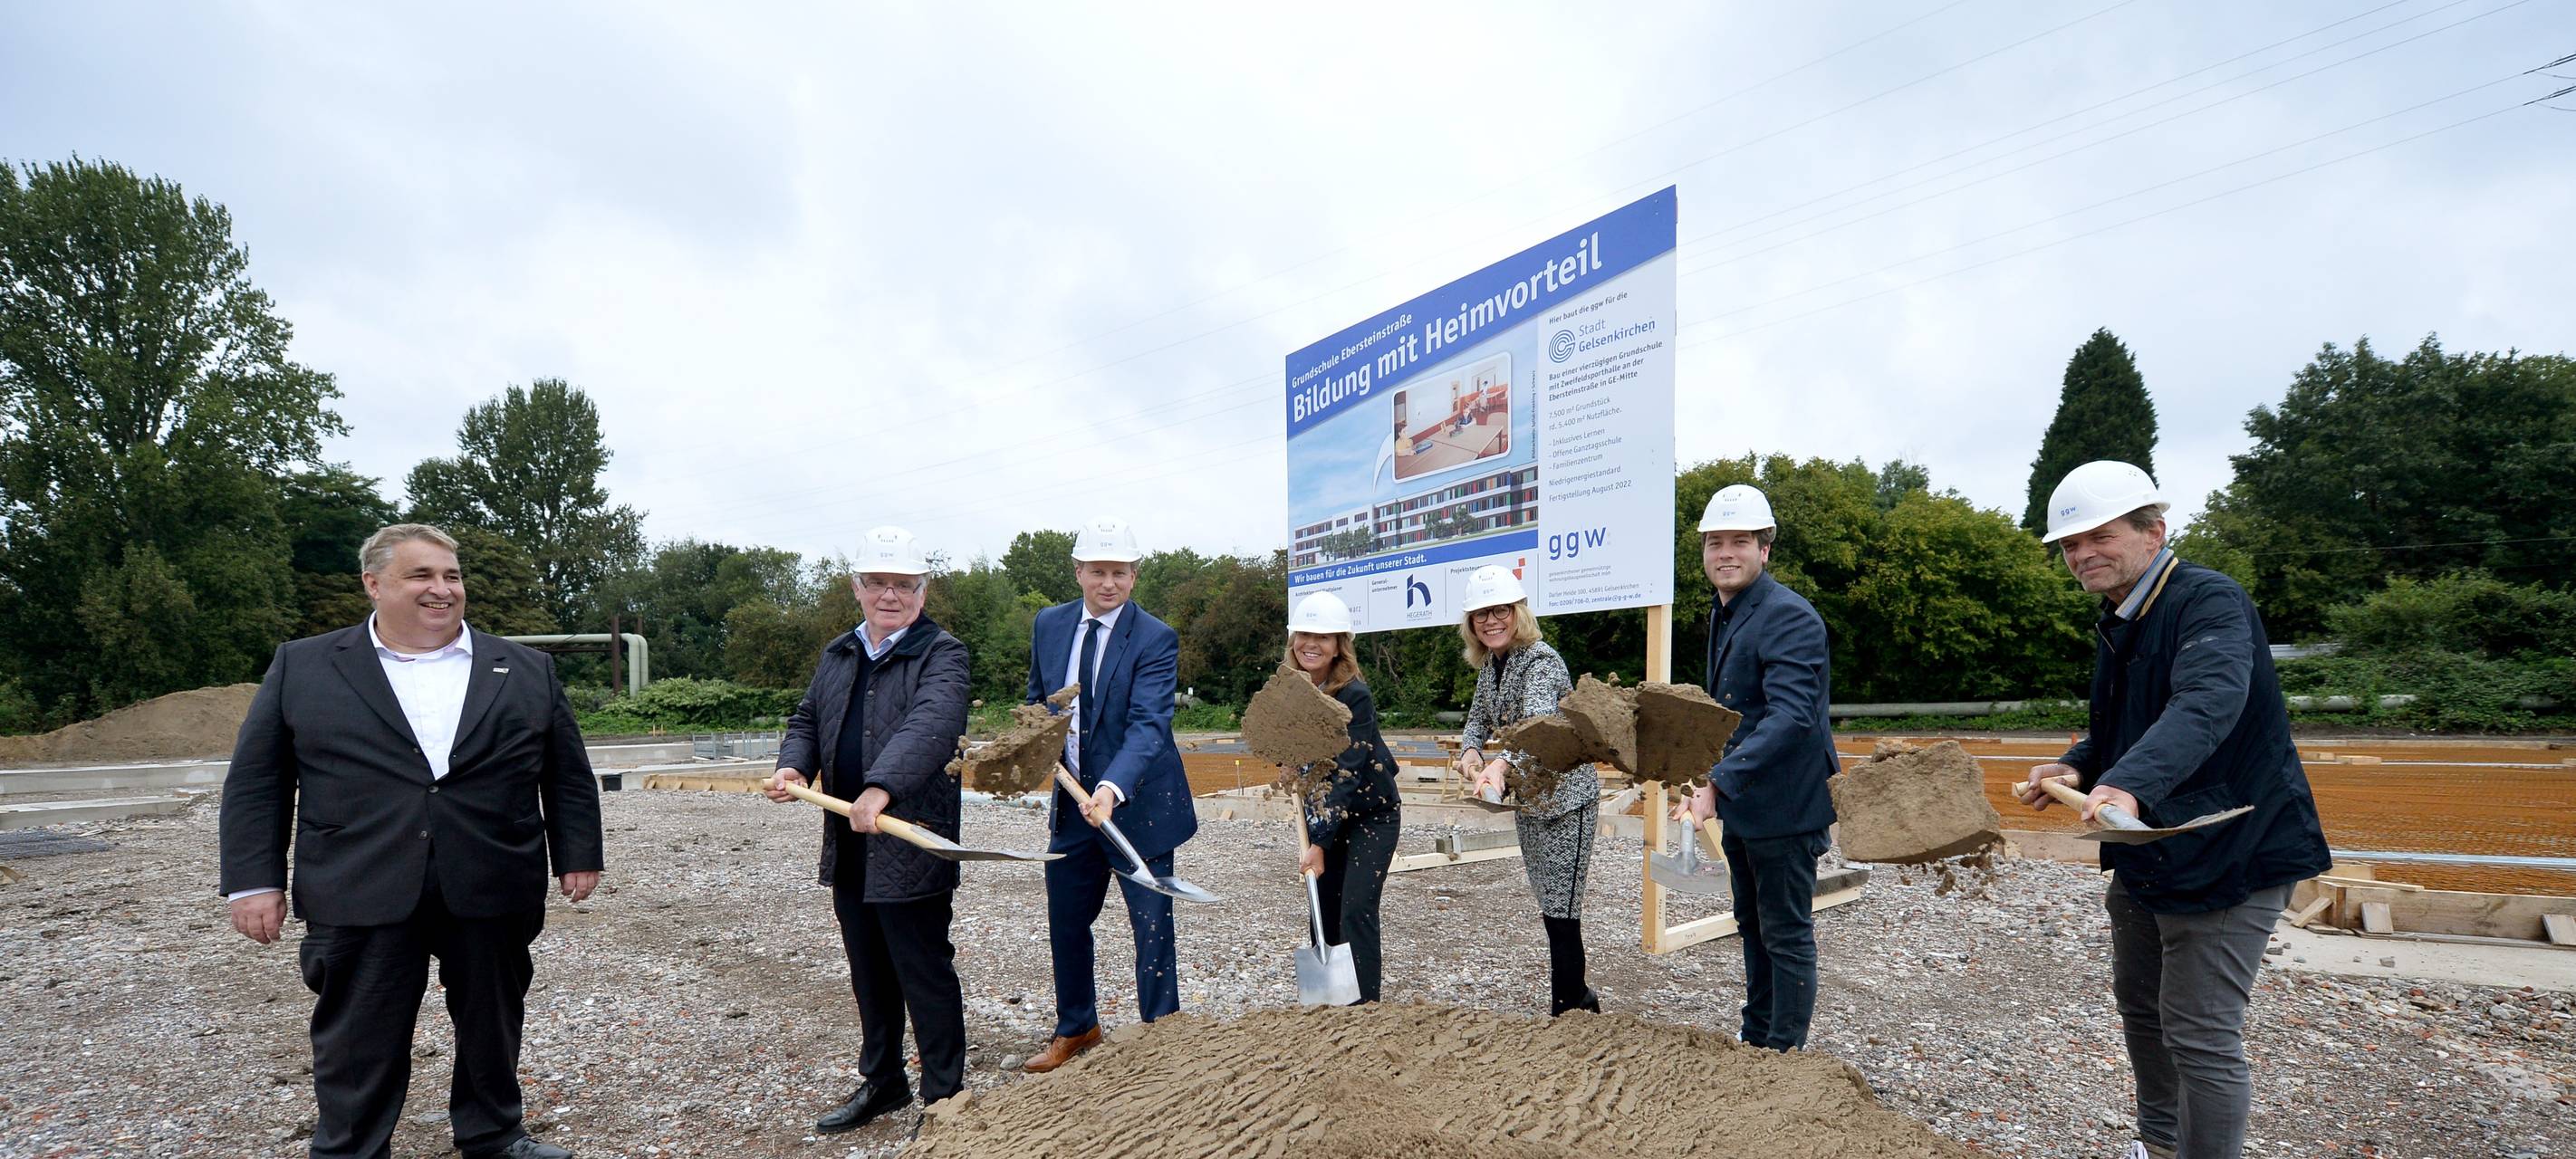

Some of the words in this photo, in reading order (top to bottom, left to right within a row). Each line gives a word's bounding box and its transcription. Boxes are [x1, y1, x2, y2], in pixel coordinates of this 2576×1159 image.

[1549, 315, 1562, 325] Hier
[1563, 310, 1578, 320] baut
[1579, 304, 1589, 314] die
[1591, 301, 1603, 311] ggw
[1605, 296, 1615, 305] für
[1617, 292, 1628, 301] die
[1293, 363, 1370, 423] Bildung
[1378, 333, 1418, 378] mit
[1426, 231, 1602, 355] Heimvorteil
[1579, 319, 1607, 337] Stadt
[1579, 320, 1656, 352] Gelsenkirchen
[1292, 354, 1340, 388] Grundschule
[1341, 313, 1412, 360] Ebersteinstraße
[1549, 373, 1561, 381] Bau
[1562, 368, 1578, 378] einer
[1579, 355, 1618, 372] vierzügigen
[1619, 340, 1663, 359] Grundschule
[1549, 381, 1560, 391] mit
[1561, 365, 1621, 388] Zweifeldsporthalle
[1622, 362, 1631, 370] an
[1632, 358, 1644, 367] der
[1549, 381, 1599, 401] Ebersteinstraße
[1600, 378, 1607, 387] in
[1608, 370, 1638, 385] GE-Mitte
[1549, 409, 1565, 419] 7.500
[1576, 396, 1610, 412] Grundstück
[1558, 418, 1576, 428] 5.400
[1552, 434, 1582, 446] Inklusives
[1583, 427, 1605, 439] Lernen
[1552, 447, 1572, 458] Offene
[1573, 436, 1622, 454] Ganztagsschule
[1552, 453, 1603, 471] Familienzentrum
[1549, 465, 1621, 487] Niedrigenergiestandard
[1549, 486, 1591, 503] Fertigstellung
[1591, 484, 1614, 495] August
[1615, 479, 1632, 490] 2022
[2061, 506, 2076, 516] ggw
[1549, 527, 1607, 560] ggw
[1294, 573, 1305, 583] Wir
[1306, 570, 1324, 581] bauen
[1325, 568, 1335, 579] für
[1336, 566, 1346, 577] die
[1348, 561, 1375, 575] Zukunft
[1376, 559, 1402, 570] unserer
[1404, 553, 1427, 566] Stadt.
[1407, 610, 1433, 618] HEGERATH
